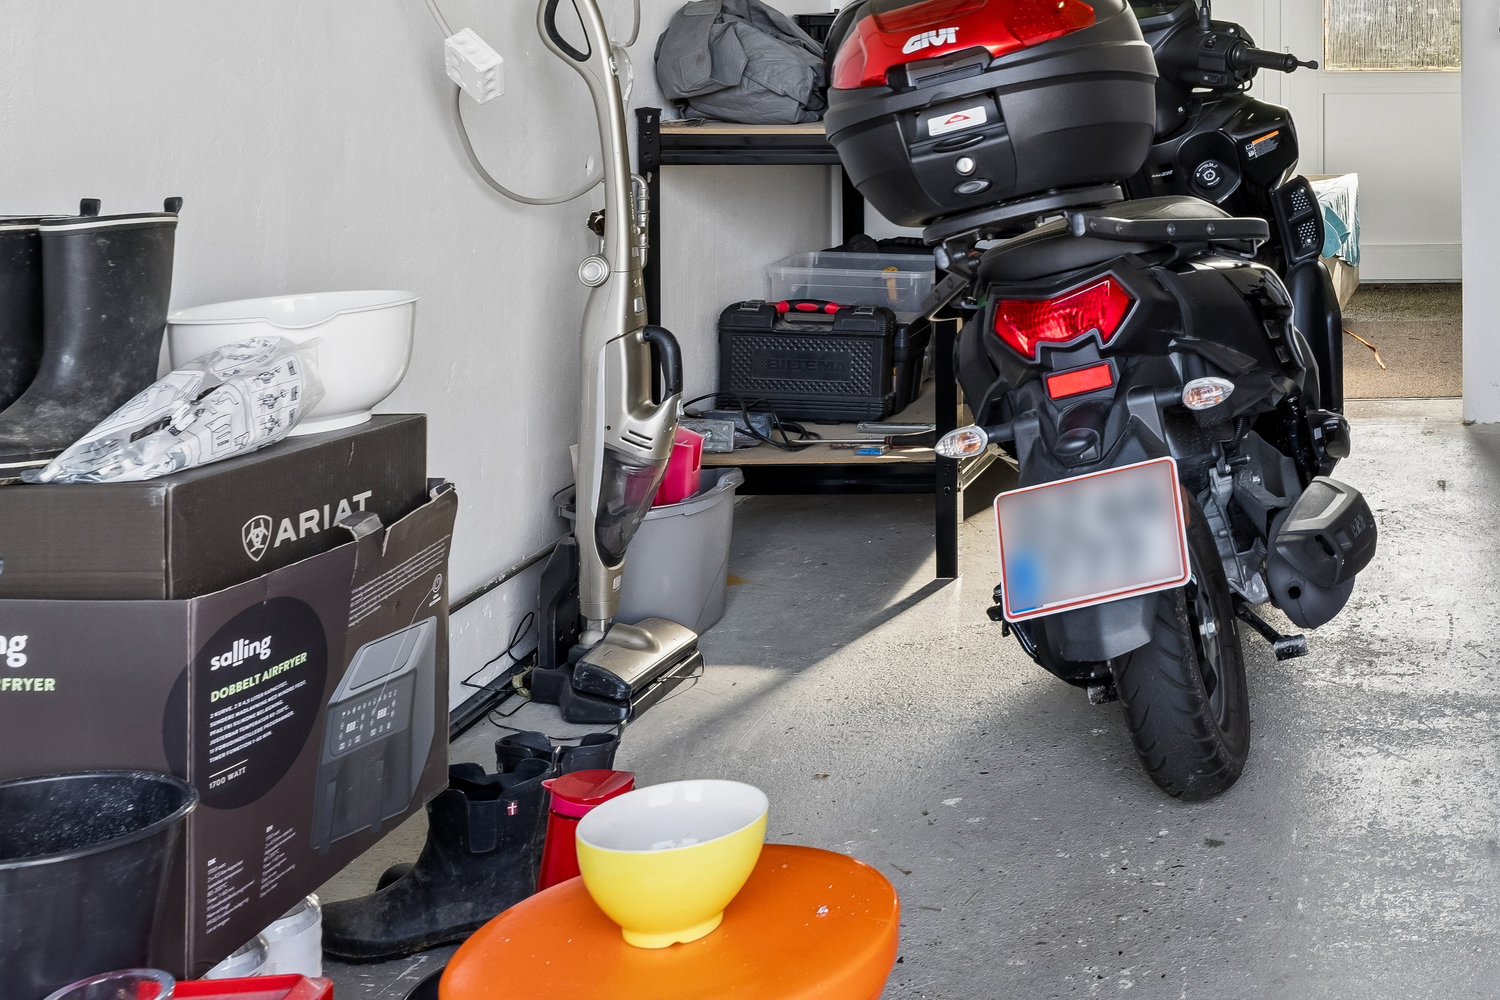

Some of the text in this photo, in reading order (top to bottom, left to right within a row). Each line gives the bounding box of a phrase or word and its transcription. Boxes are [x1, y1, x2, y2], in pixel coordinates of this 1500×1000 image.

[902, 27, 957, 54] GIVI
[768, 358, 846, 372] BILTEMA
[273, 490, 372, 548] ARIAT
[210, 635, 272, 671] salling
[0, 677, 56, 692] FRYER
[210, 652, 308, 703] DOBBELT AIRFRYER
[208, 766, 247, 790] 1700 WATT
